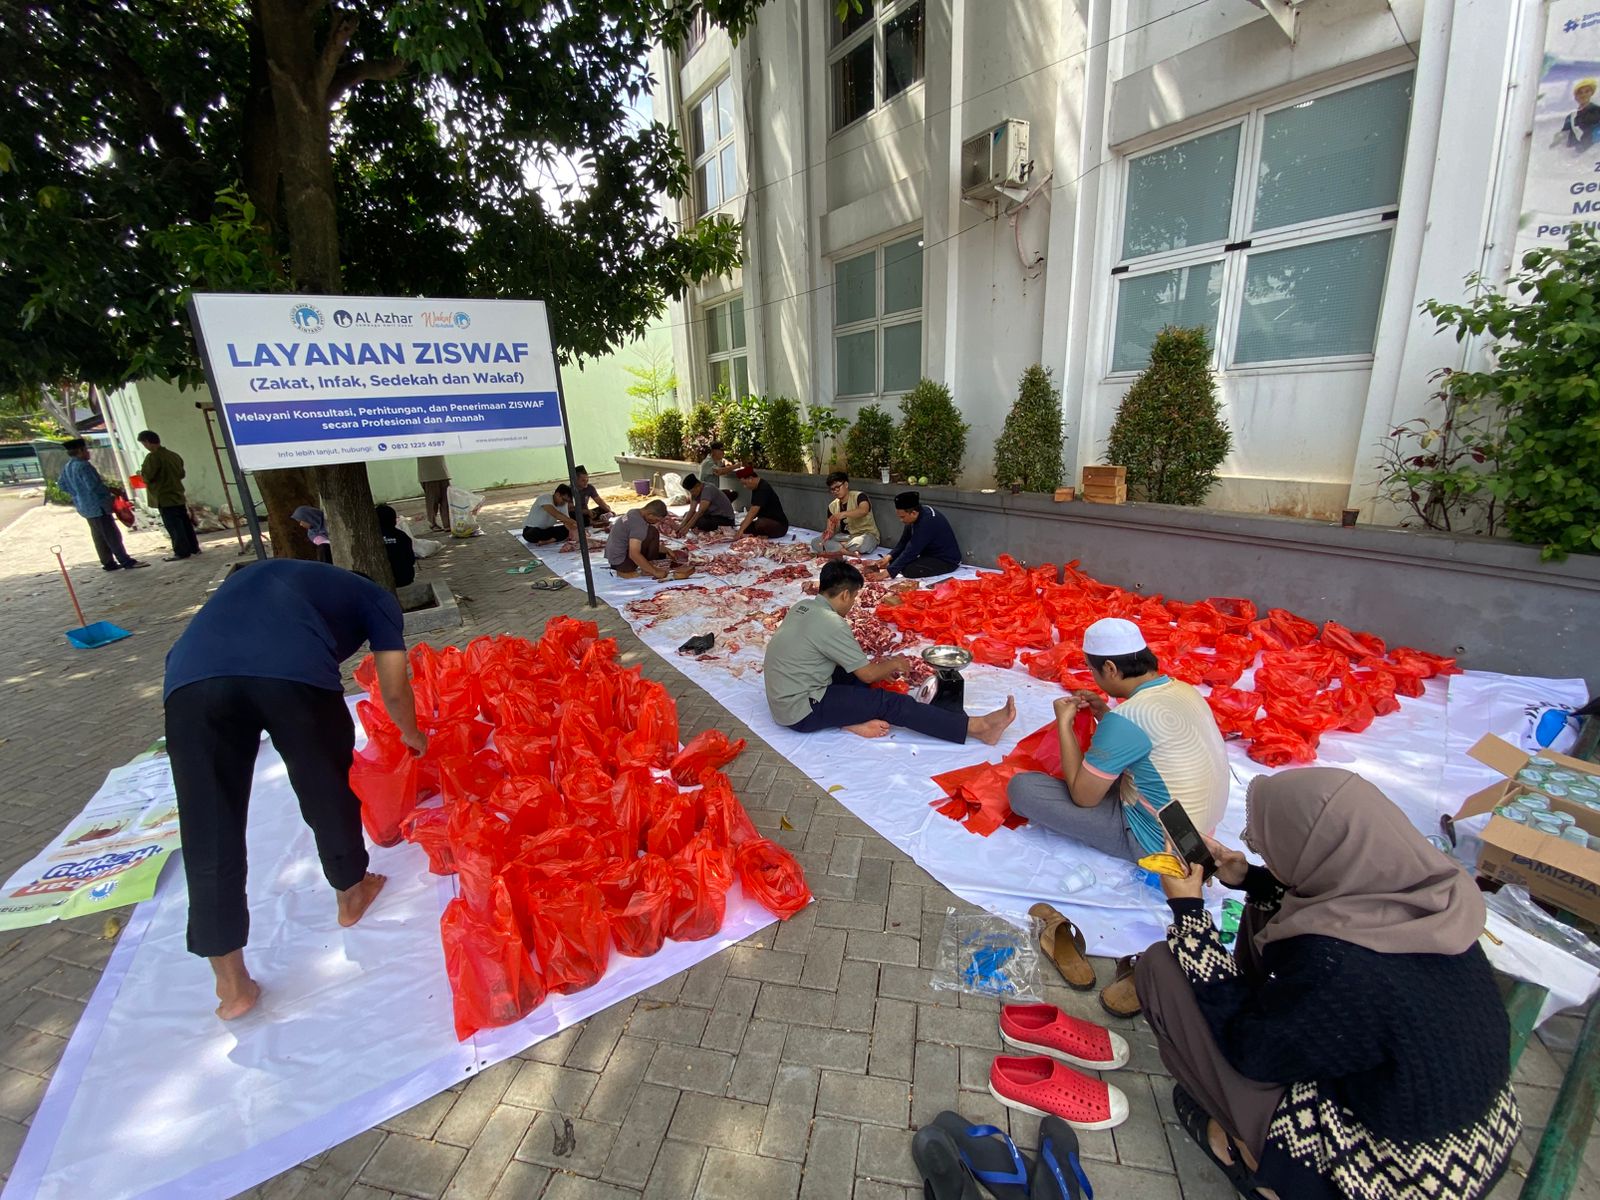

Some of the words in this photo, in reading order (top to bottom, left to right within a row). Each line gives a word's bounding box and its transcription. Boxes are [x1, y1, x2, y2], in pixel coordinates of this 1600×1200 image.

[1570, 182, 1600, 195] Ge
[356, 312, 370, 323] Al
[375, 312, 413, 324] Azhar
[227, 343, 405, 367] LAYANAN
[412, 342, 529, 364] ZISWAF
[250, 376, 315, 392] (Zakat,
[318, 375, 367, 390] Infak,
[370, 373, 438, 387] Sedekah
[442, 373, 470, 384] dan
[473, 372, 525, 384] Wakaf)
[235, 410, 291, 423] Melayani
[294, 408, 357, 419] Konsultasi,
[359, 405, 427, 416] Perhitungan,
[429, 404, 448, 413] dan
[450, 402, 506, 412] Penerimaan
[508, 400, 545, 409] ZISWAF
[322, 421, 359, 430] secara
[361, 416, 421, 428] Profesional
[423, 415, 443, 424] dan
[445, 413, 485, 423] Amanah
[428, 440, 446, 448] 4587
[278, 451, 294, 459] Info
[295, 449, 315, 458] lebih
